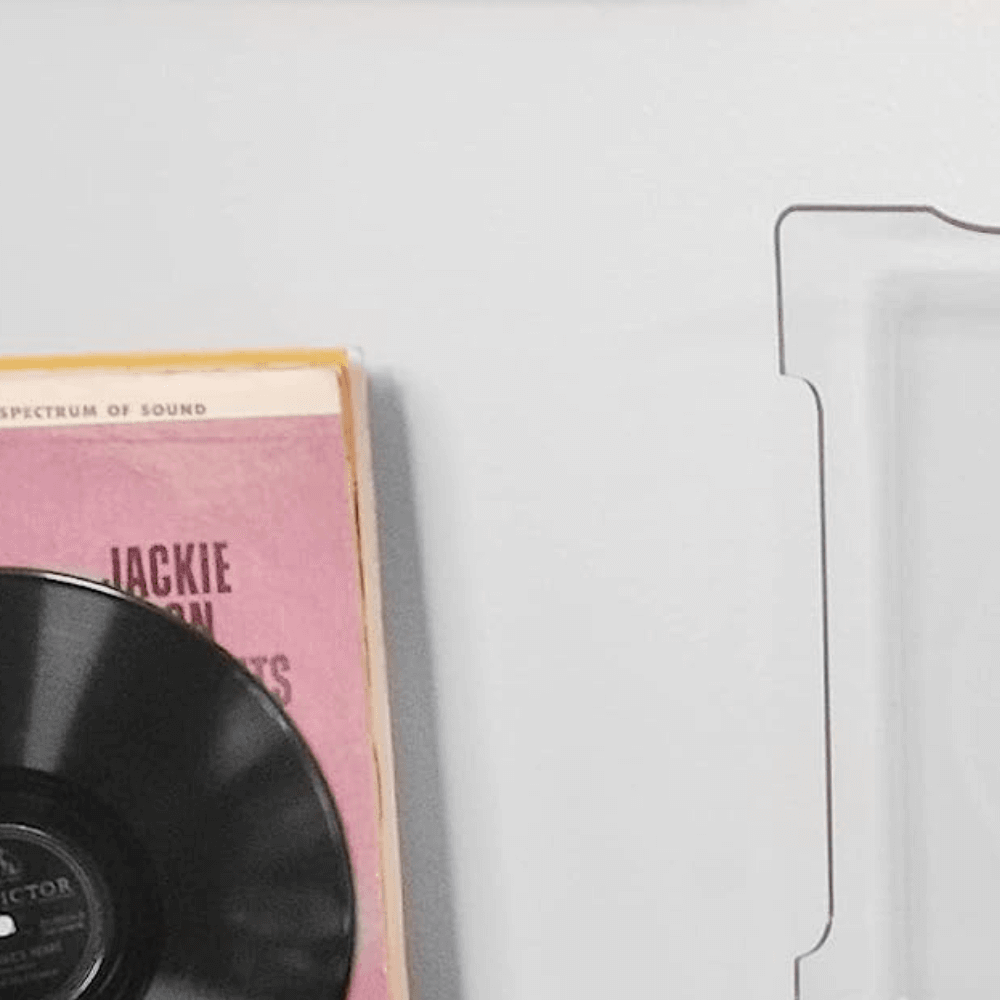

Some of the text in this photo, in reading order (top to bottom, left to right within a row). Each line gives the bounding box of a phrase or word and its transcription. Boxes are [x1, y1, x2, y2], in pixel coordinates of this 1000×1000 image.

[0, 402, 207, 419] SPECTRUM OF SOUND
[103, 541, 232, 597] JACKIE
[1, 877, 71, 902] ICTOR
